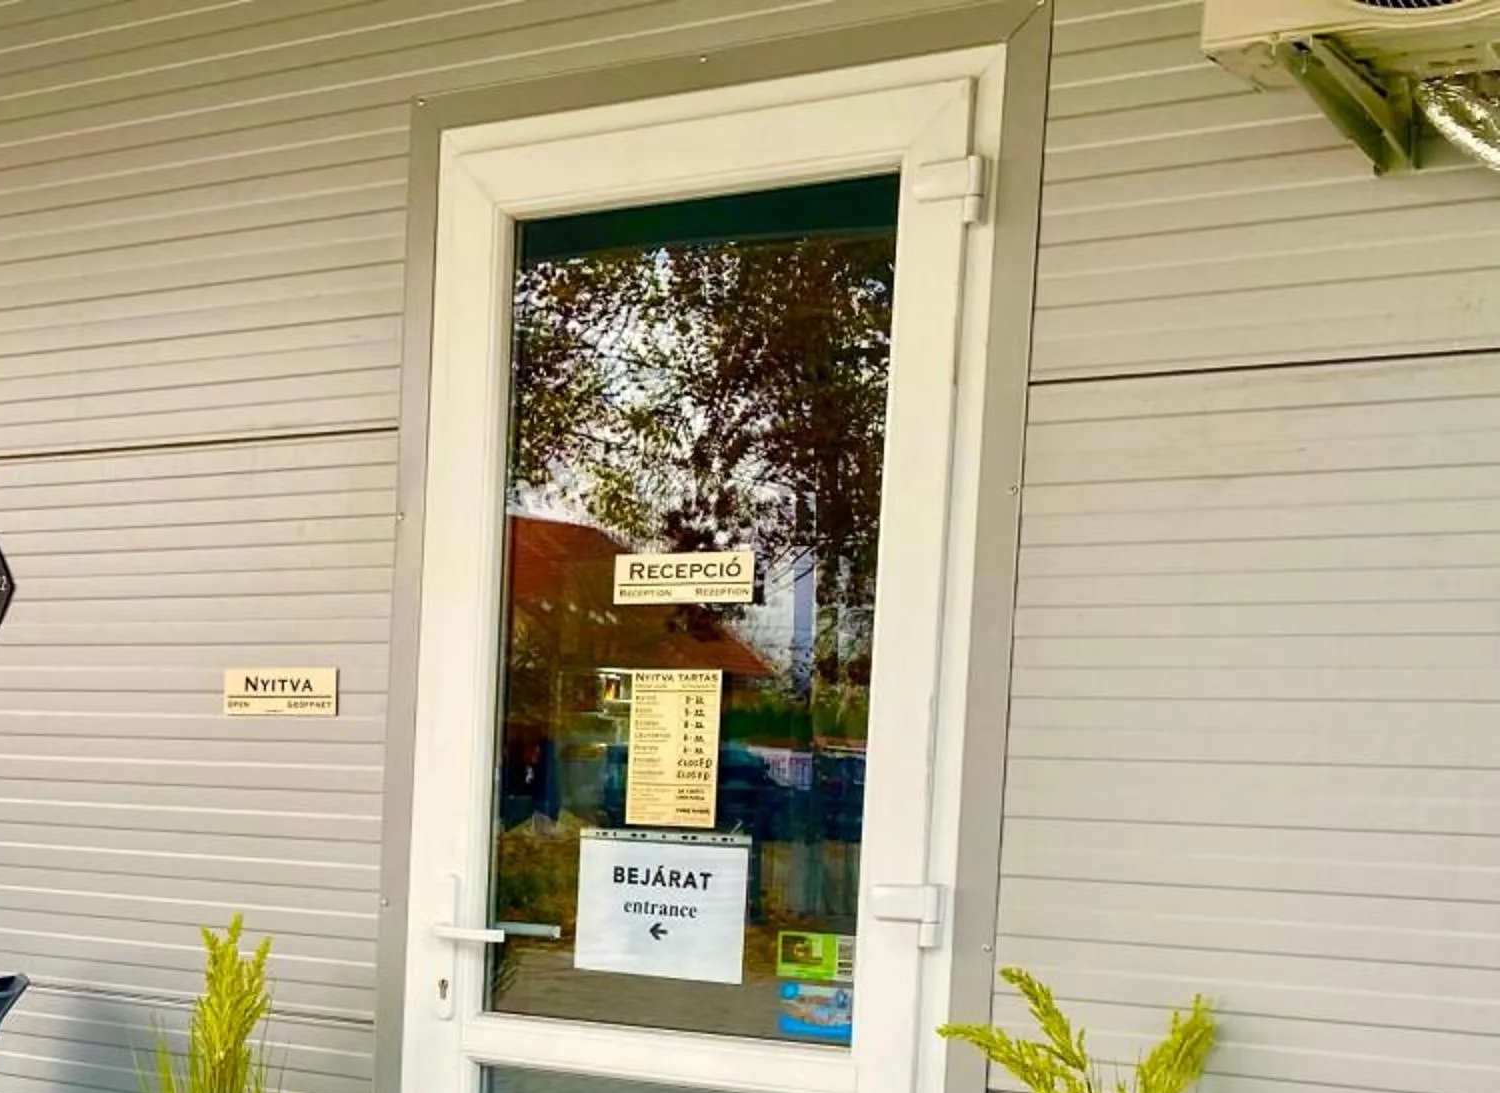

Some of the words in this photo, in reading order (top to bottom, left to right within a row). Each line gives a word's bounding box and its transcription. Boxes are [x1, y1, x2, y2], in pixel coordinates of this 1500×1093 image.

[629, 556, 742, 580] RECEPCIÓ
[619, 588, 672, 597] RECEPTION
[695, 586, 749, 596] REZEPTION
[244, 675, 313, 692] NYITVA
[613, 865, 713, 891] BEJÁRAT
[623, 901, 697, 918] entrance
